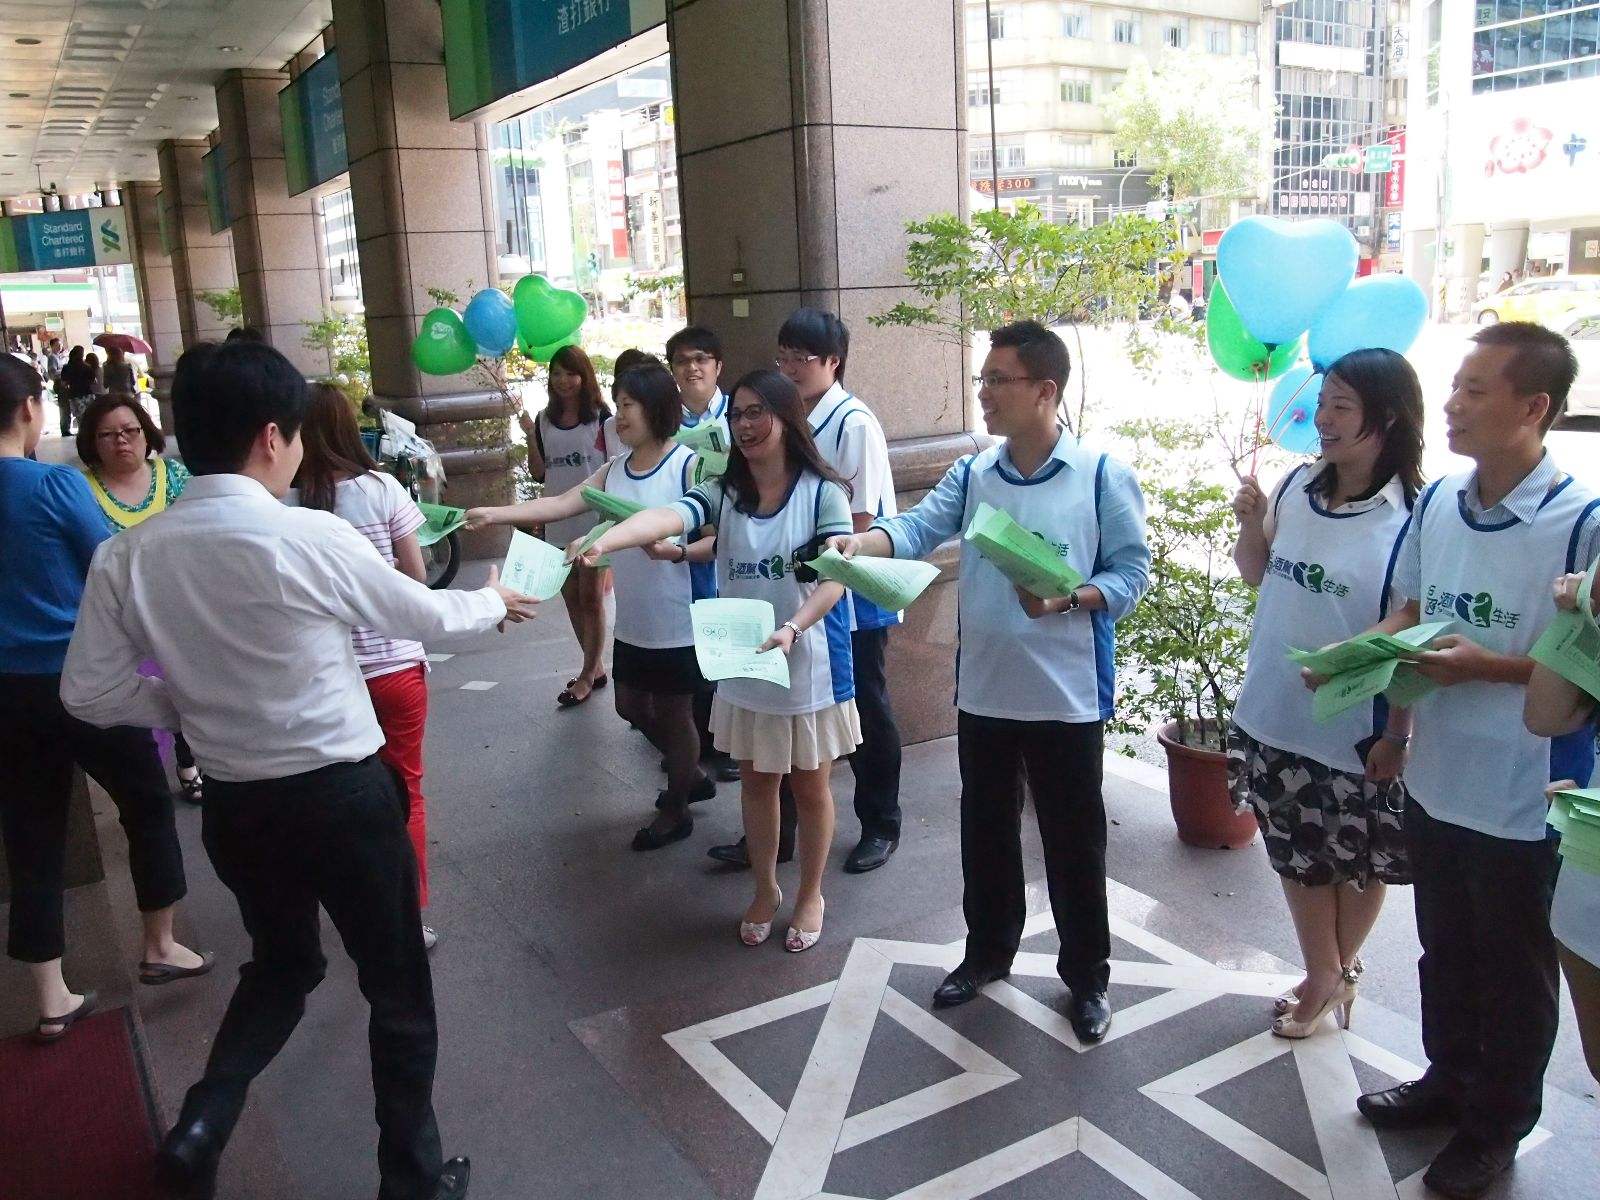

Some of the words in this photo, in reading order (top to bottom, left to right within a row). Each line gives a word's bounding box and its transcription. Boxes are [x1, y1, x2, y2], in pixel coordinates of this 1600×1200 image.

[43, 222, 83, 234] Standard
[41, 235, 85, 247] Chartered
[1322, 578, 1351, 598] 生活
[1491, 606, 1521, 630] 生活
